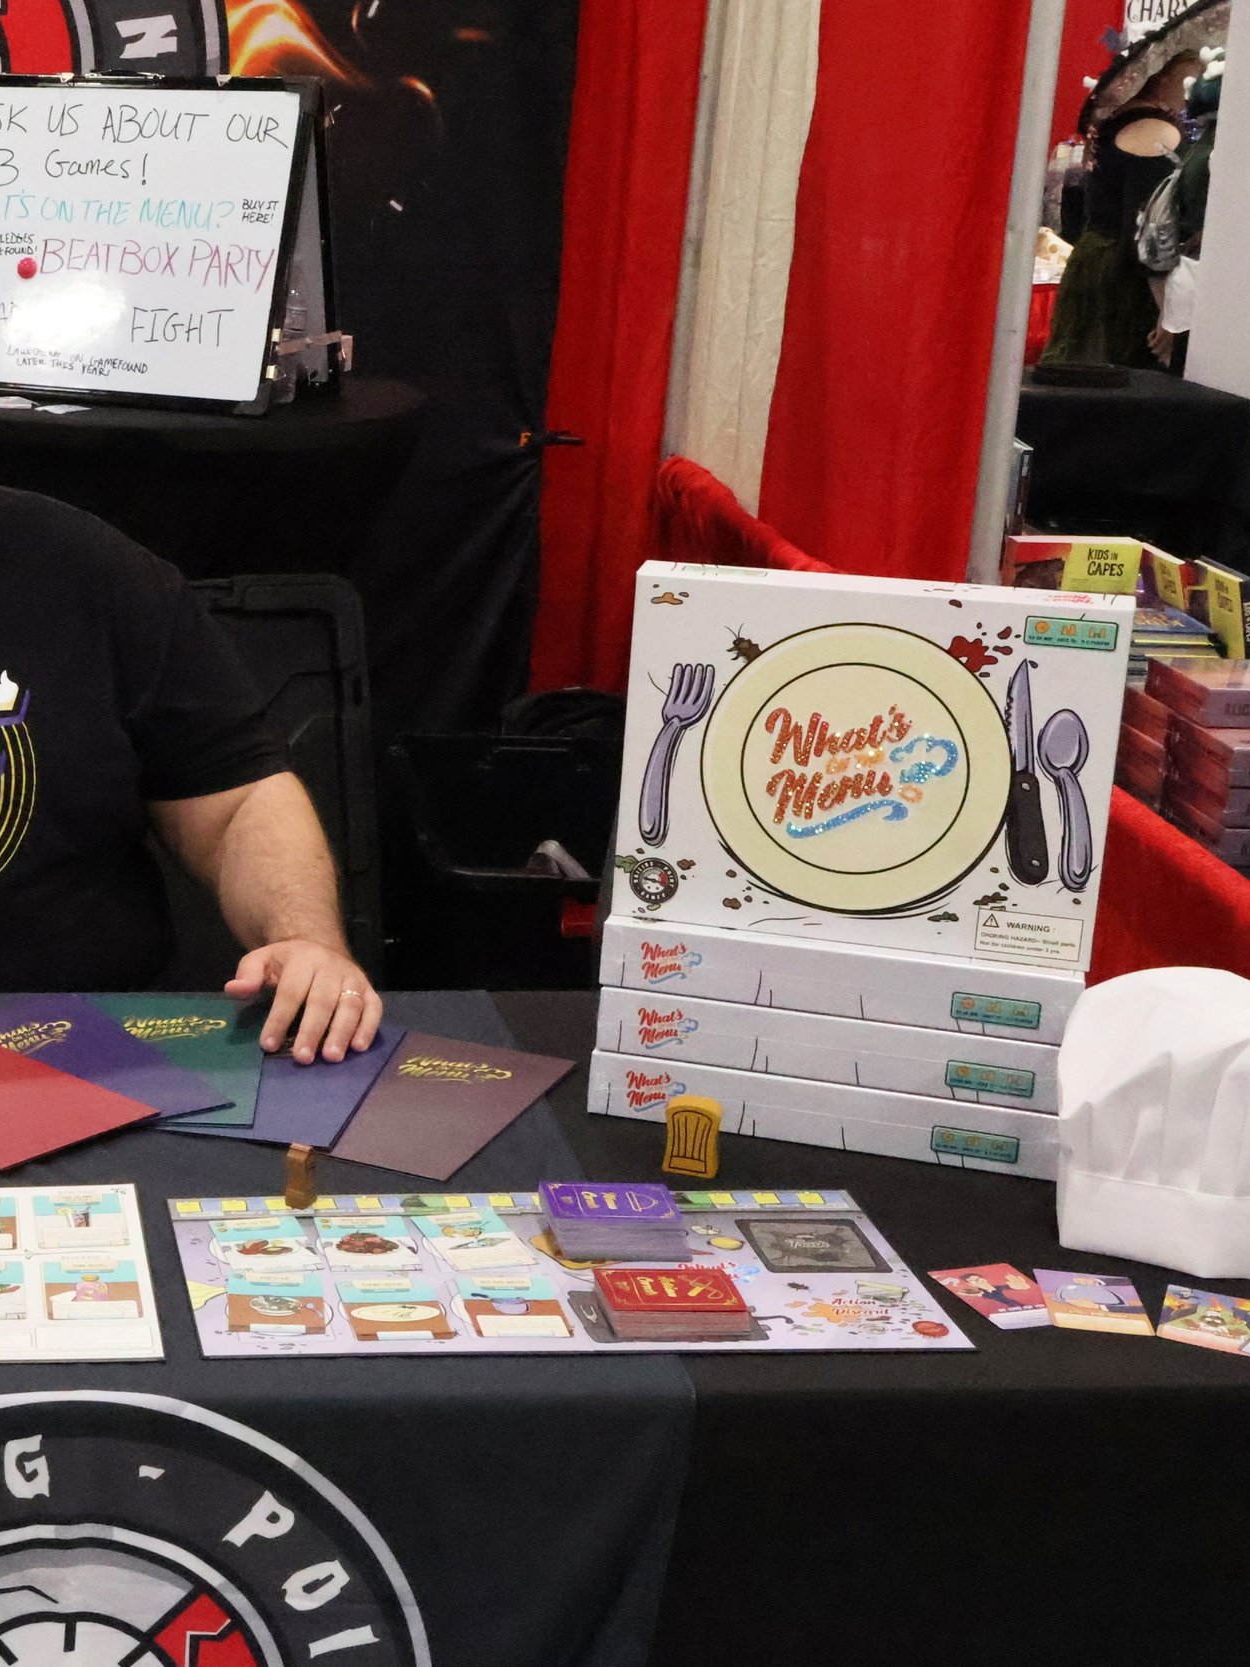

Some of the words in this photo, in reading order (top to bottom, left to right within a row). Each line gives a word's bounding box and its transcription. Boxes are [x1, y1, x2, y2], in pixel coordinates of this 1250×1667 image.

[48, 104, 83, 136] US
[102, 104, 211, 143] ABOUT
[226, 113, 289, 149] OUR
[45, 149, 150, 186] Games!
[242, 198, 264, 211] BUY
[265, 200, 279, 211] IT
[41, 196, 74, 224] ON
[80, 198, 130, 225] THE
[139, 196, 237, 233] MENU?
[242, 211, 275, 224] HERE!
[188, 240, 276, 294] PARTY
[130, 306, 236, 348] FIGHT
[16, 357, 46, 367] LATER
[51, 359, 75, 371] THIS
[89, 356, 149, 374] GAMEFOUND
[1087, 548, 1109, 561] KIDS
[1110, 553, 1118, 561] IN
[1087, 561, 1124, 577] CAPES
[765, 704, 912, 767] What's
[766, 768, 893, 825] Menu
[640, 941, 687, 961] What's
[642, 961, 682, 979] Menu
[637, 1007, 684, 1027] What's
[638, 1026, 678, 1045] Menu
[625, 1070, 671, 1089] What's
[626, 1090, 666, 1108] Menu
